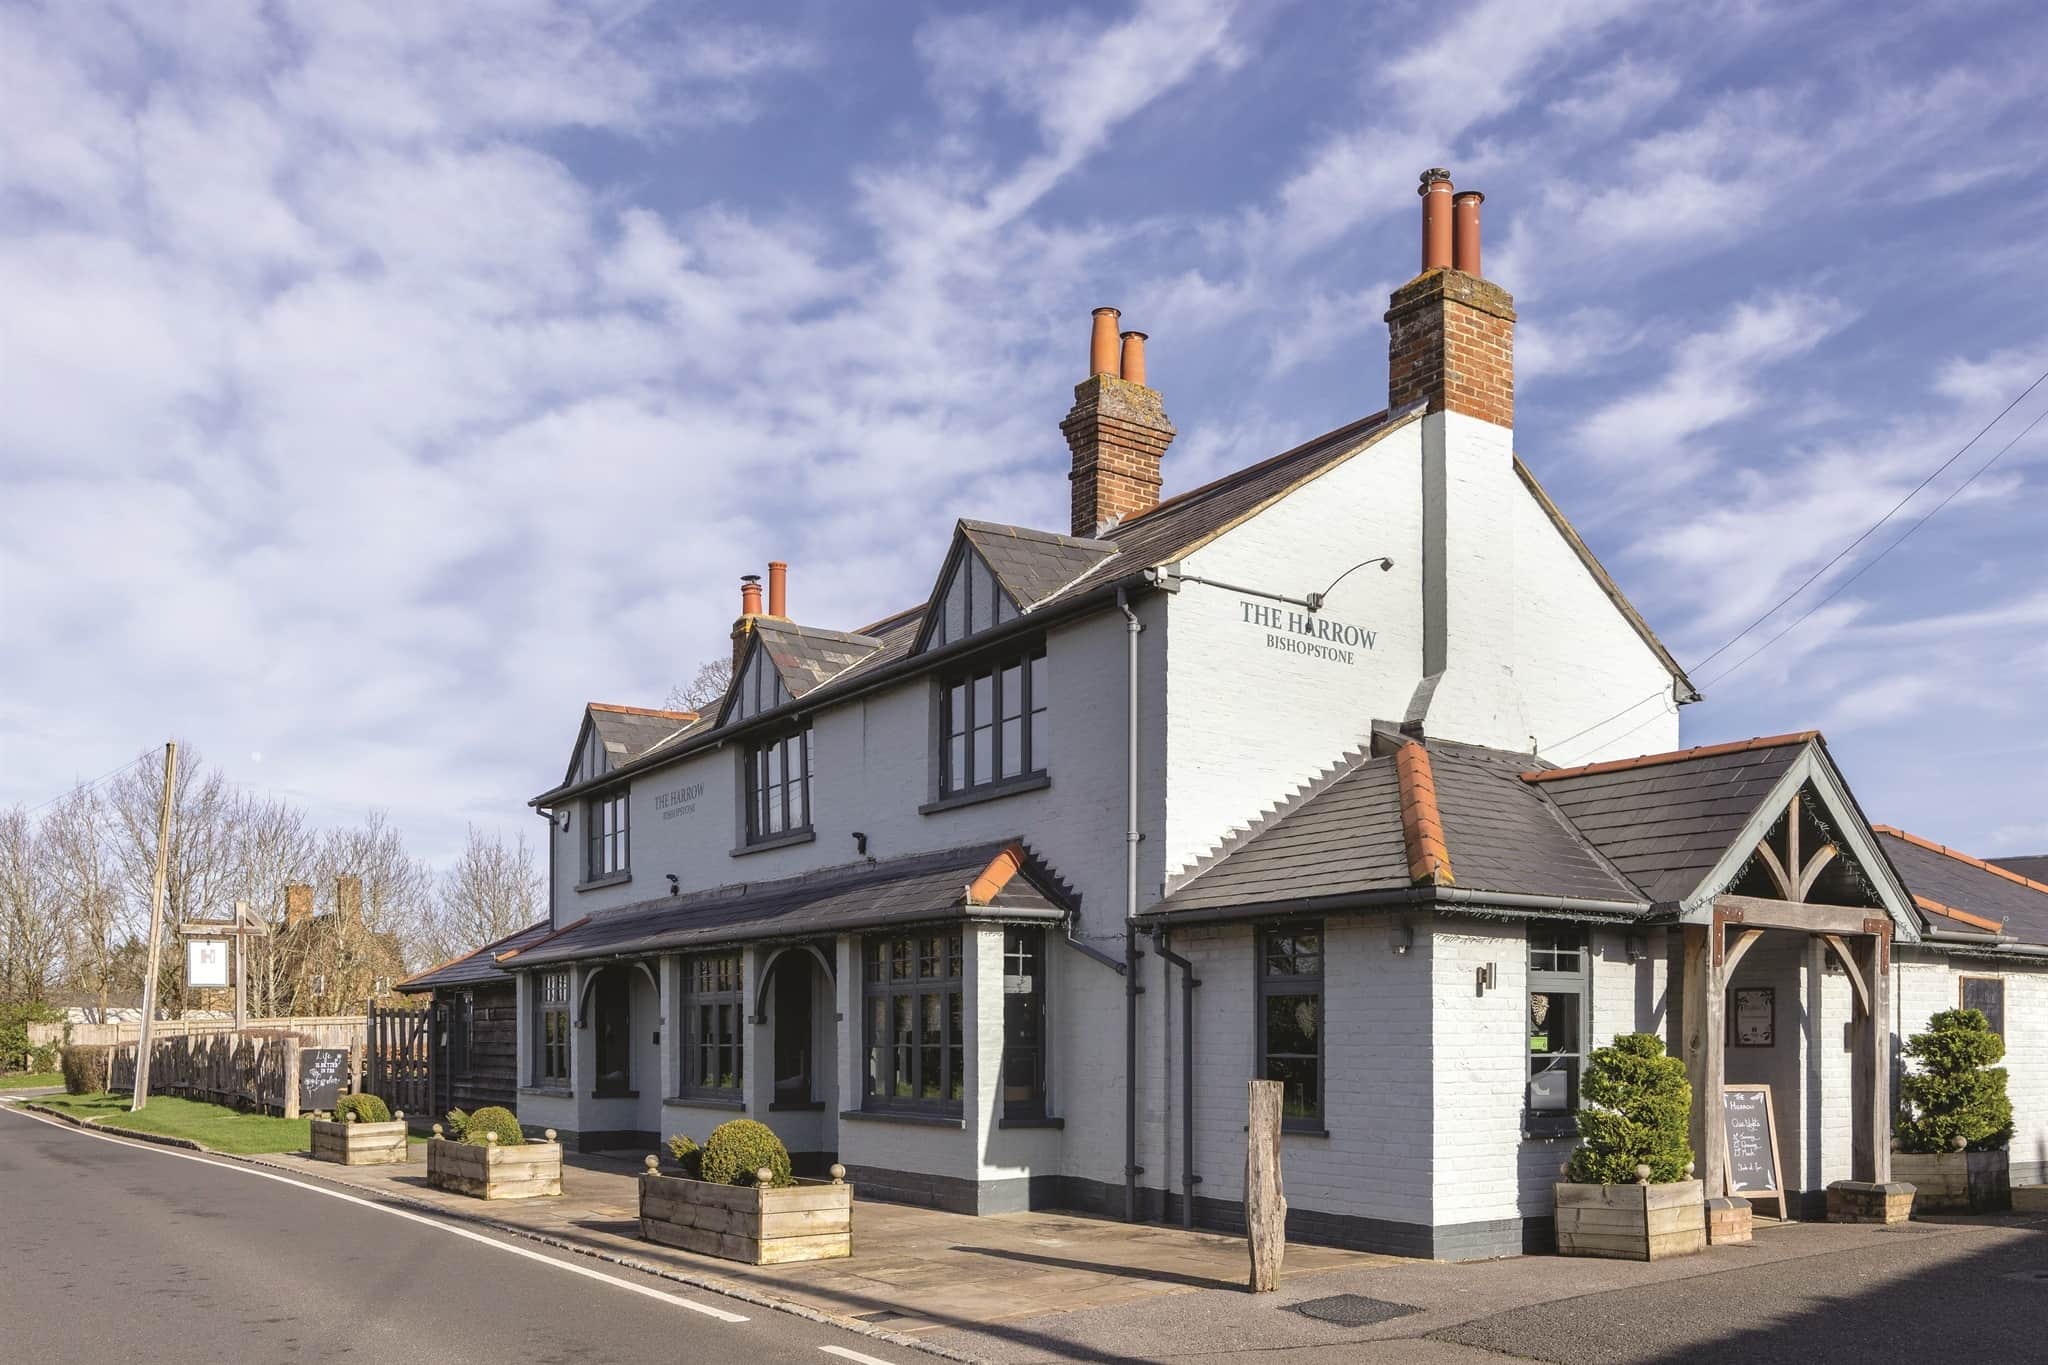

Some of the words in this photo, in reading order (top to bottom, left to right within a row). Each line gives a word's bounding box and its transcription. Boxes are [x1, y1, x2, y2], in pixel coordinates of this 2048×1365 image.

[1240, 601, 1282, 630] THE
[1288, 612, 1378, 650] HARROW
[1266, 633, 1354, 665] BISHOPSTONE
[655, 793, 669, 810] THE
[670, 782, 704, 806] HARROW
